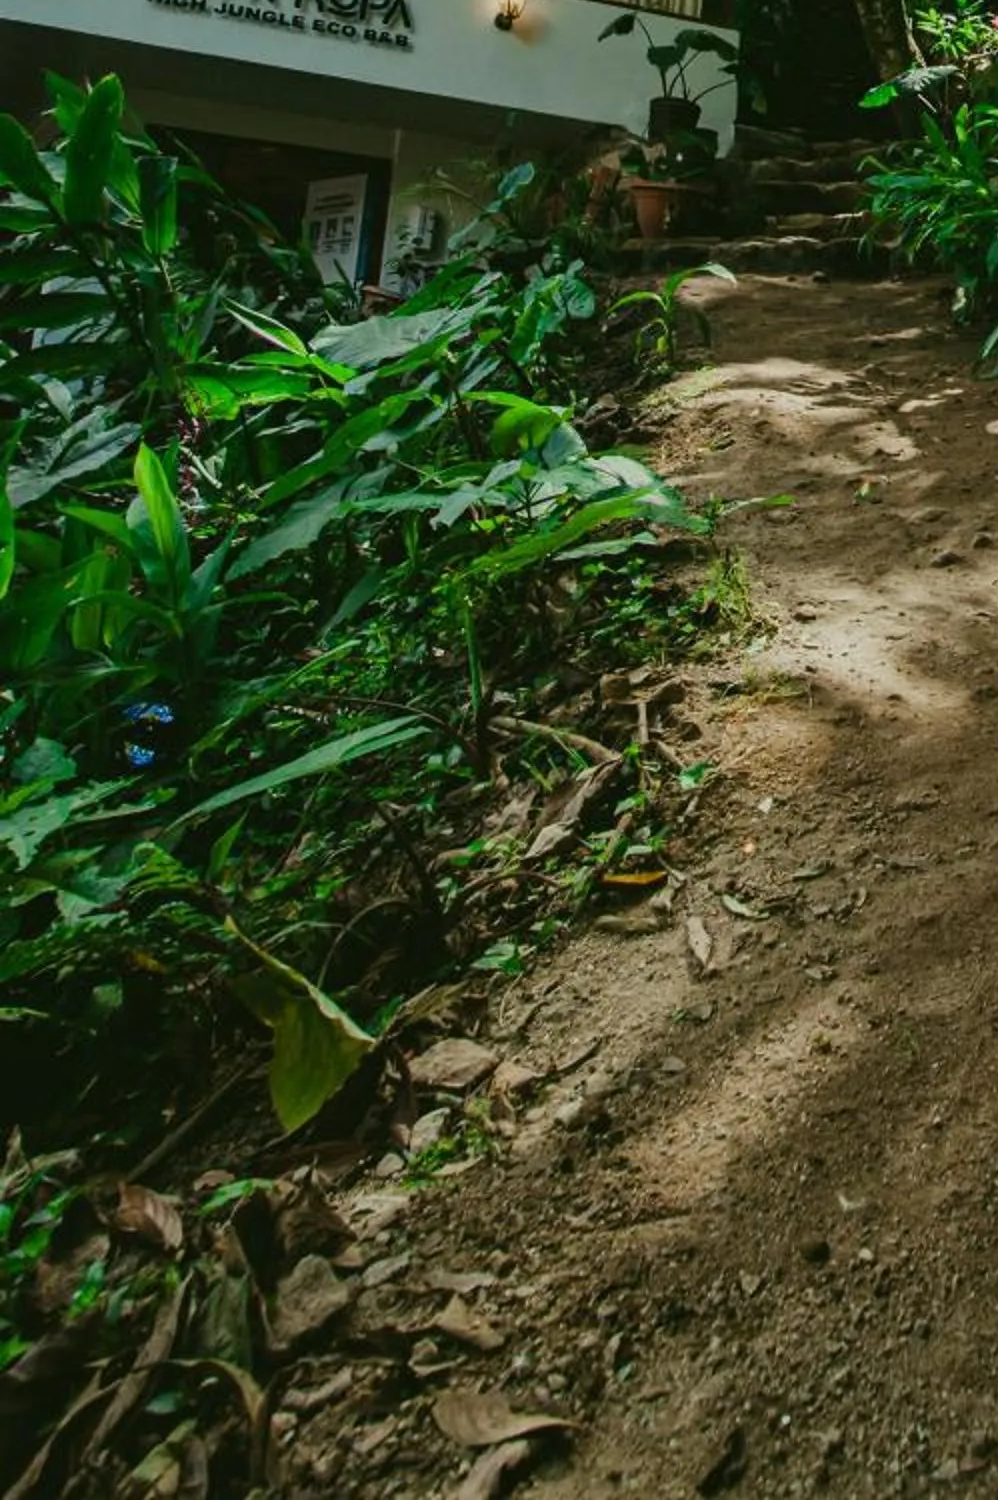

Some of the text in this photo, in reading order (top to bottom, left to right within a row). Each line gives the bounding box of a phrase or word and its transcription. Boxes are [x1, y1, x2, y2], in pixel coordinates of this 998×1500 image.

[214, 2, 305, 29] JUNGLE
[312, 18, 357, 38] ECO
[363, 29, 409, 47] B&B
